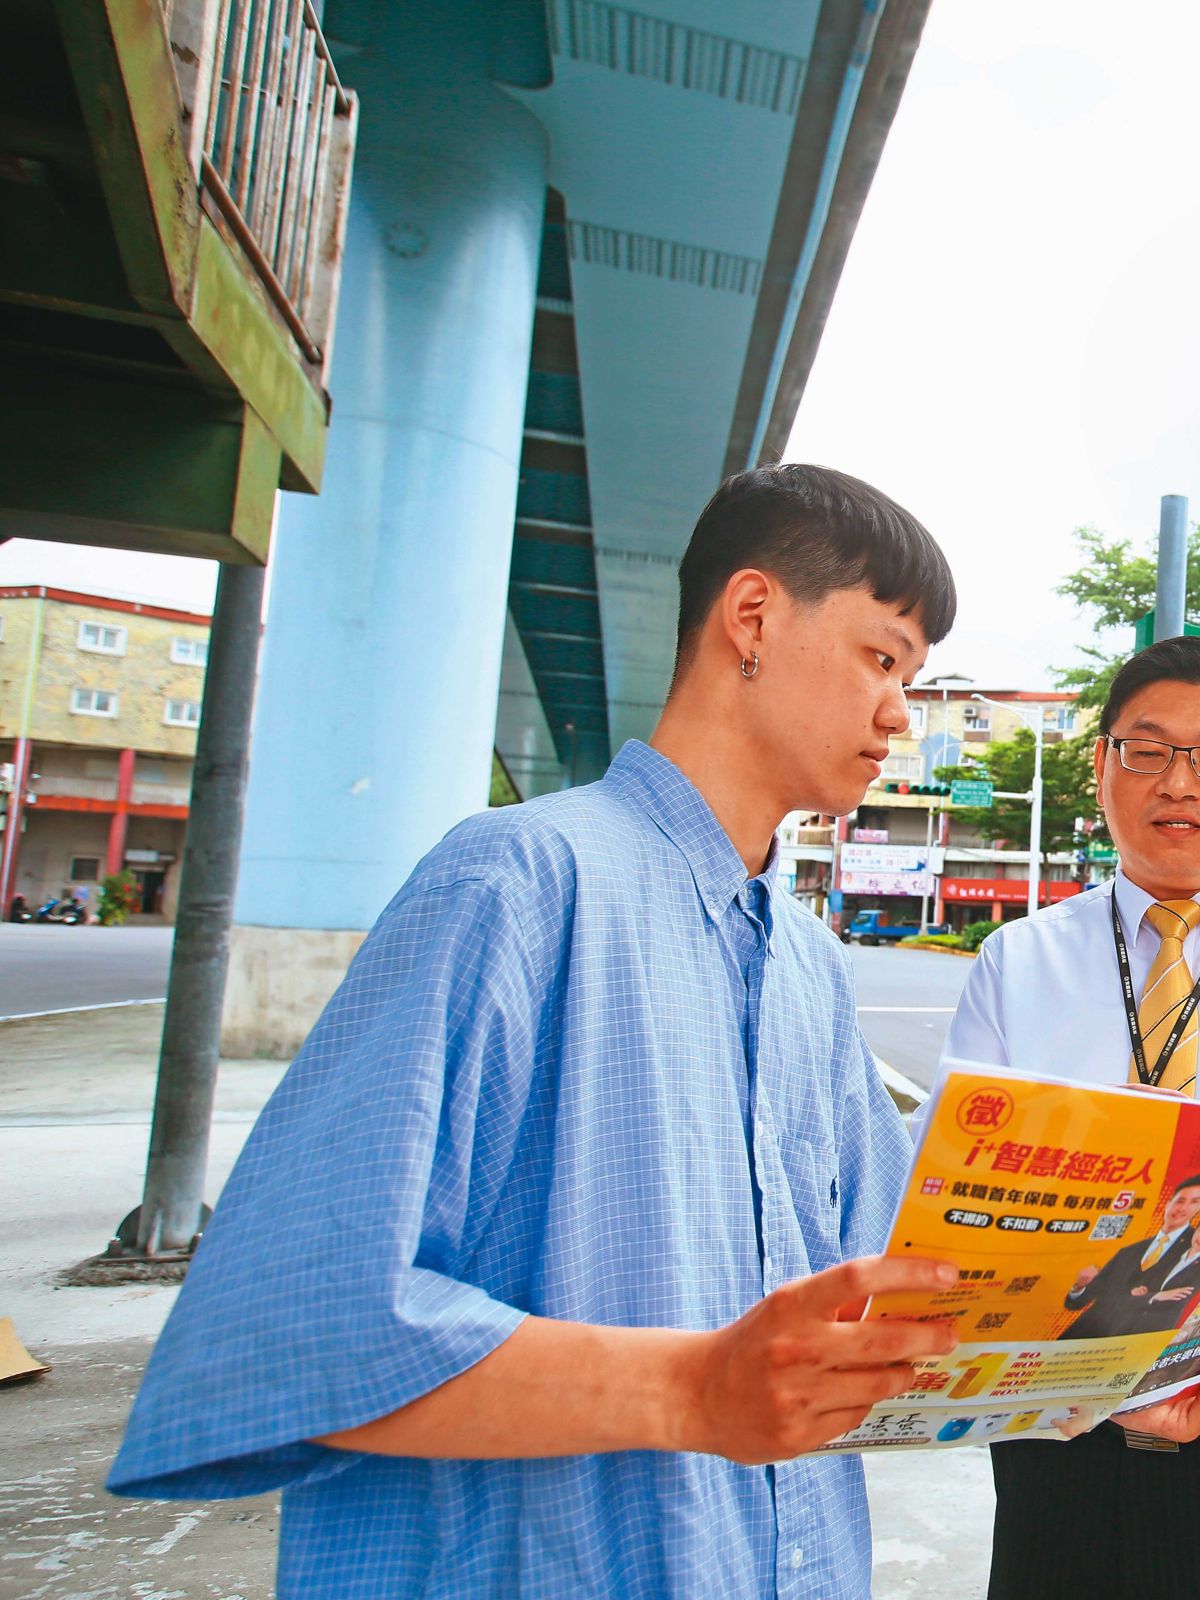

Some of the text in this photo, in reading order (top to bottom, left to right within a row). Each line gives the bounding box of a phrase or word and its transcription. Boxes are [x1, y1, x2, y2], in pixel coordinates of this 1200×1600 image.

[965, 1094, 1006, 1127] 徵
[951, 1181, 1059, 1208] 就職首年保障
